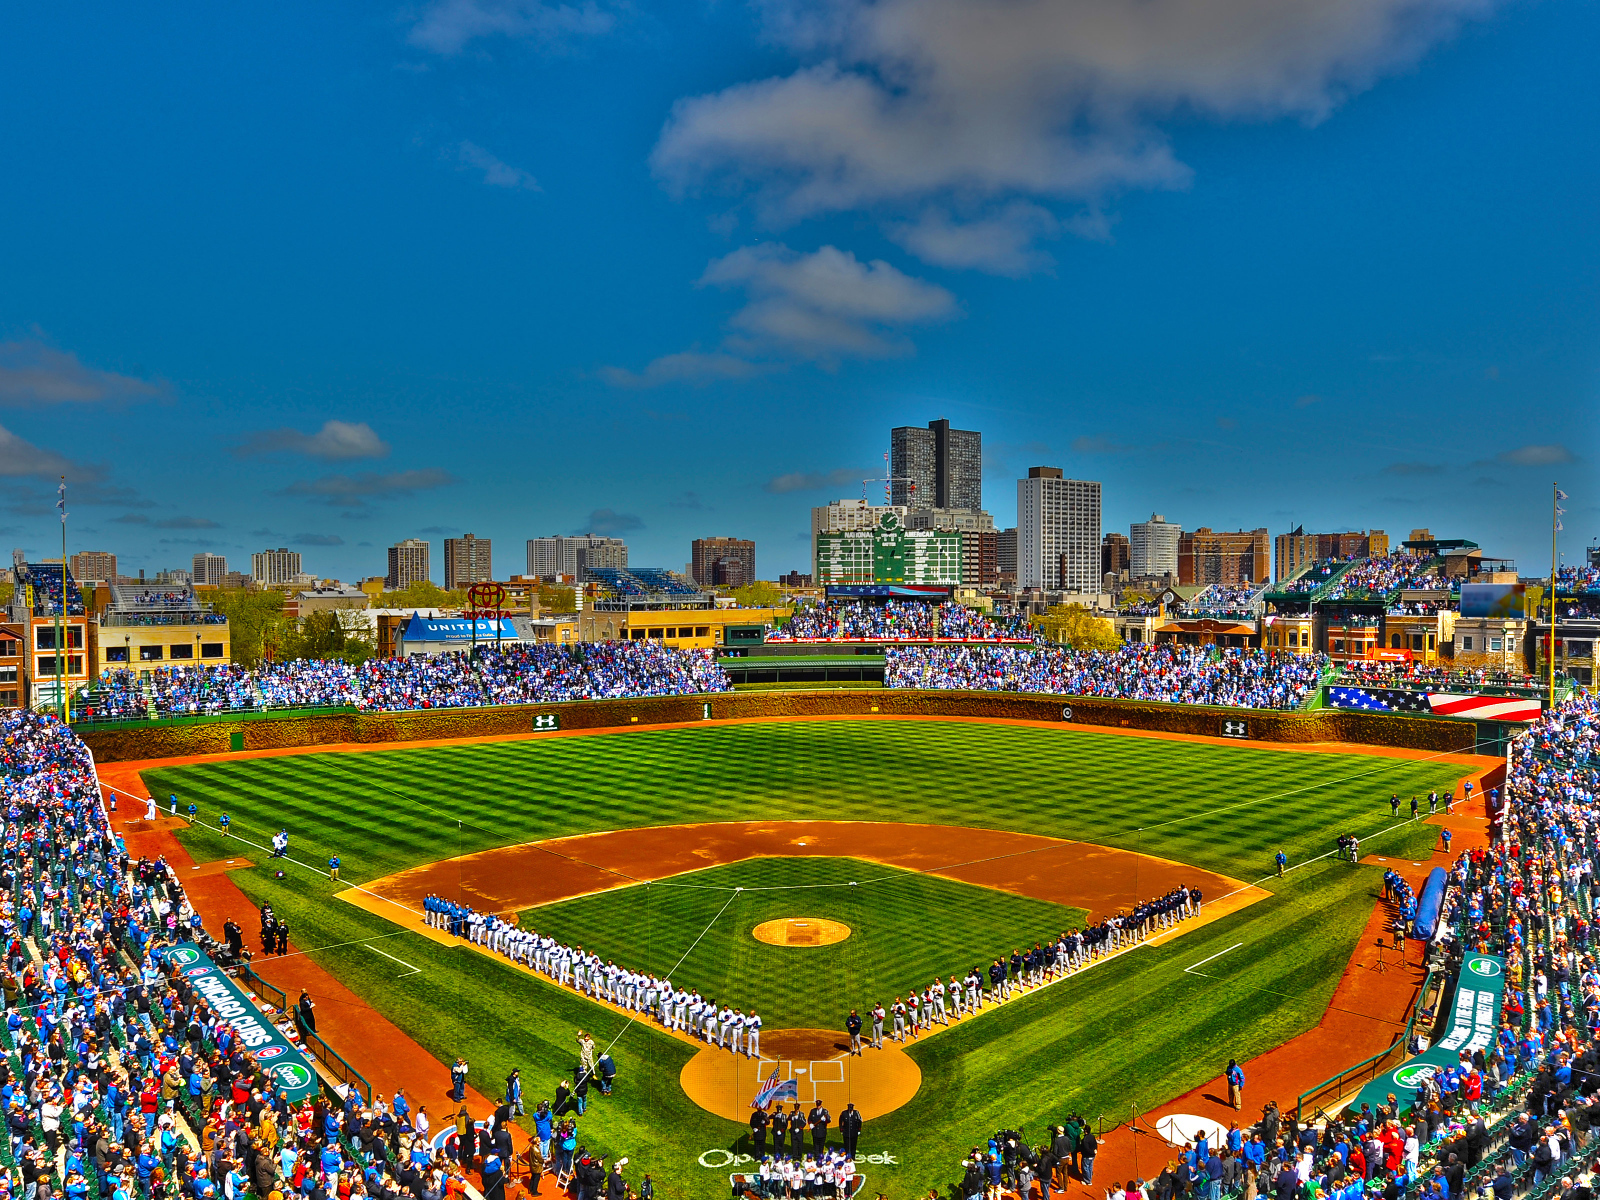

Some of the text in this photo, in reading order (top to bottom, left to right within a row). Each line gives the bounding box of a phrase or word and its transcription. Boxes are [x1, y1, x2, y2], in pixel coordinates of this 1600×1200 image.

[461, 610, 513, 621] TOYOTA
[427, 623, 487, 631] UNITED
[193, 976, 273, 1047] CHICAGO CUBS
[275, 1066, 302, 1087] Scotts
[854, 1150, 899, 1165] eek
